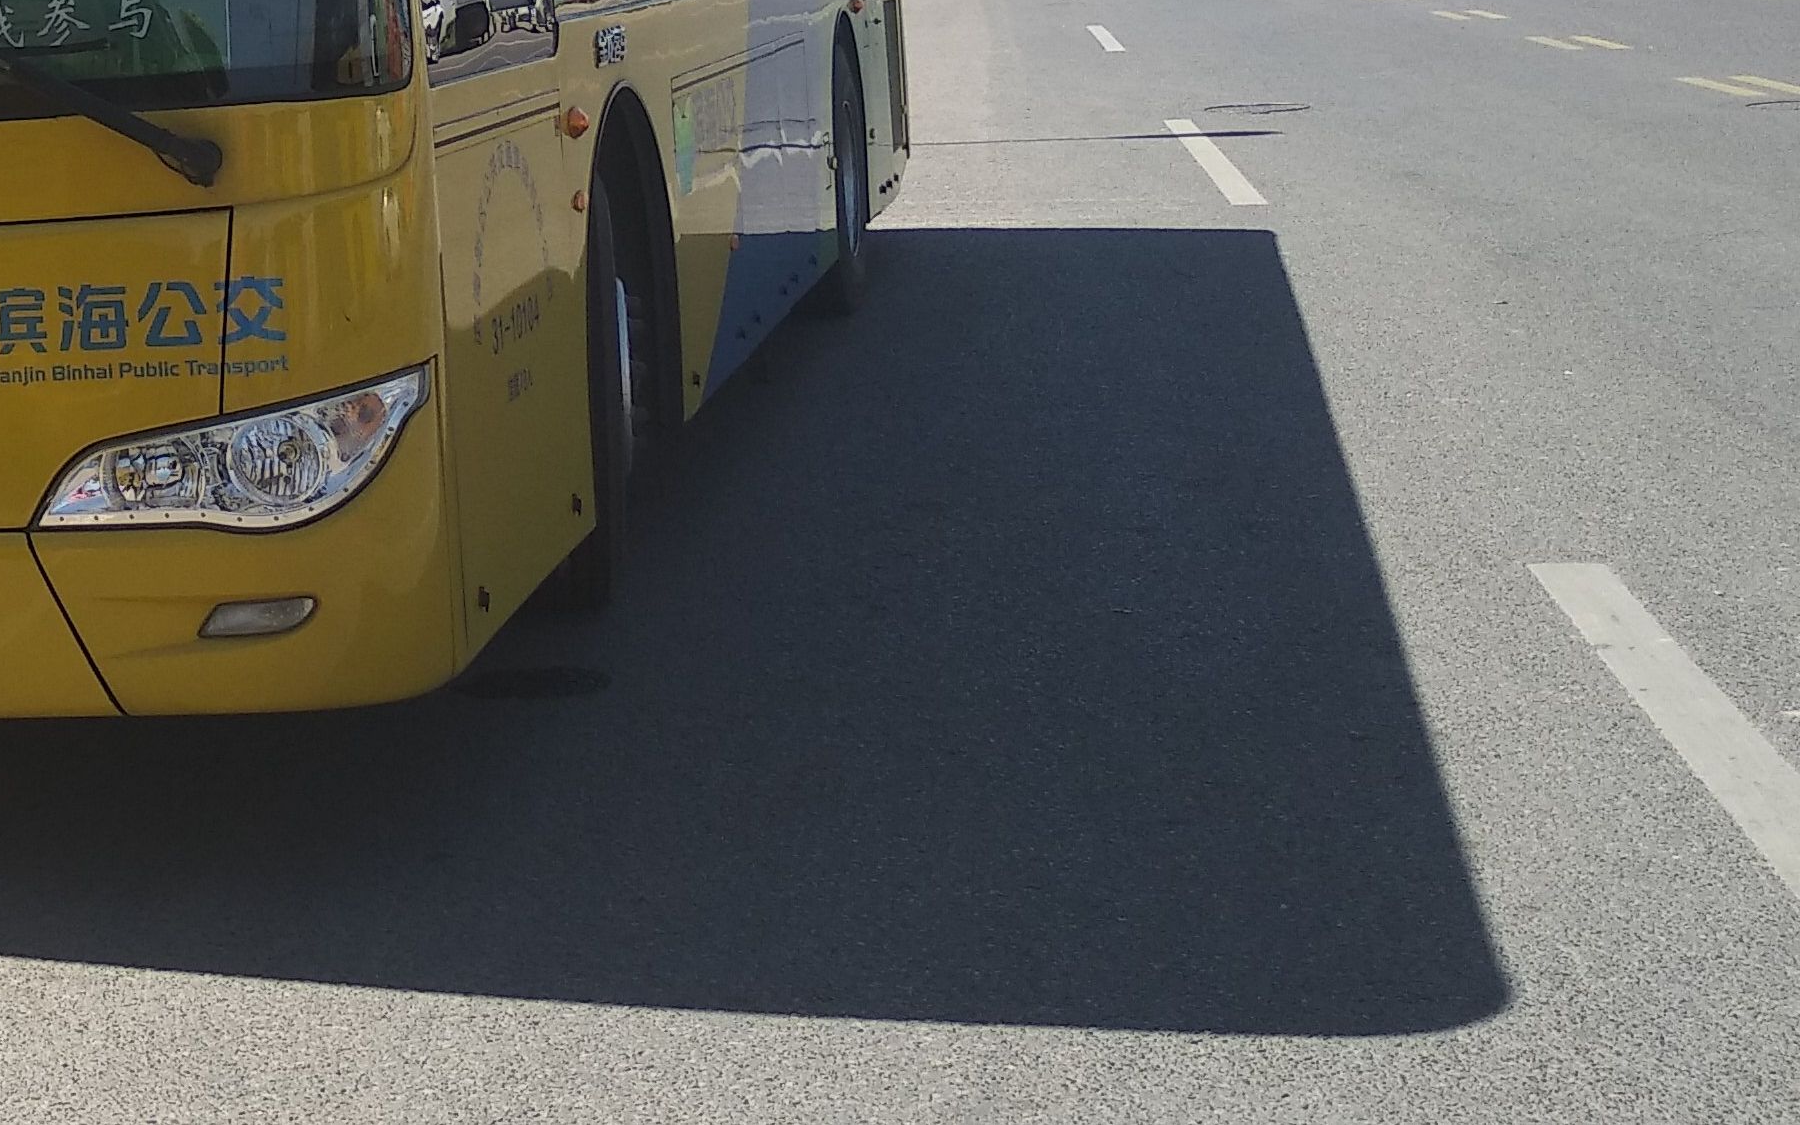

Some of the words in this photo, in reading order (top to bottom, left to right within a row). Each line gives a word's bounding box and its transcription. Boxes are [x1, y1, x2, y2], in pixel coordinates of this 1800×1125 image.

[52, 364, 113, 382] Binhai
[119, 361, 179, 379] Public
[185, 354, 290, 384] Transport
